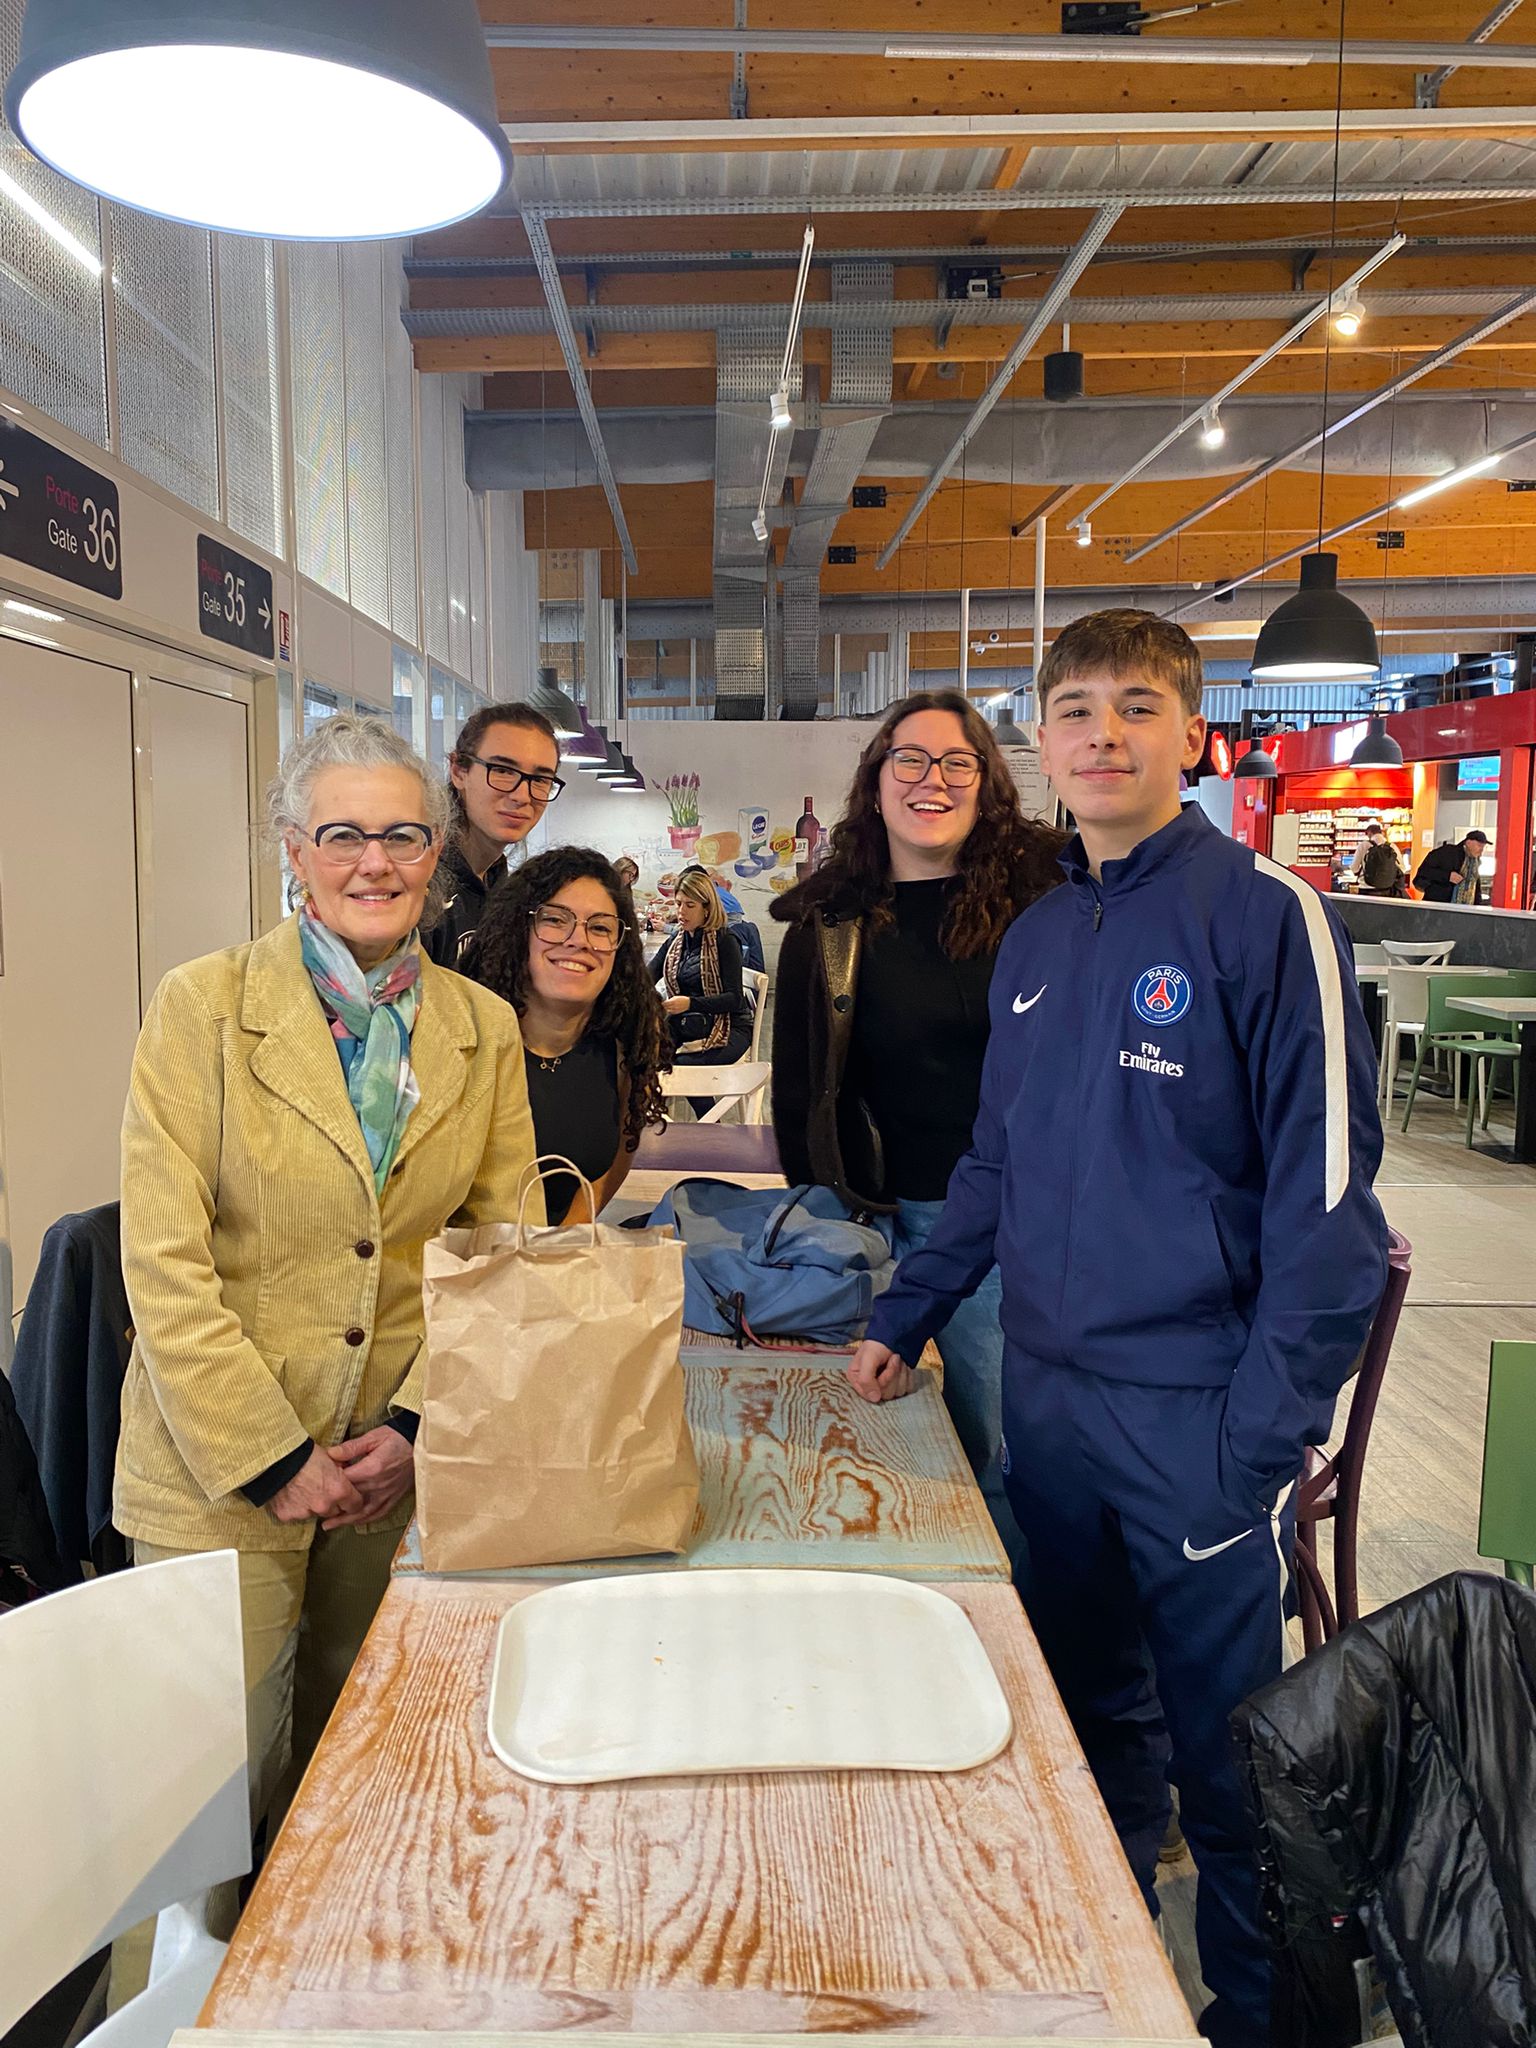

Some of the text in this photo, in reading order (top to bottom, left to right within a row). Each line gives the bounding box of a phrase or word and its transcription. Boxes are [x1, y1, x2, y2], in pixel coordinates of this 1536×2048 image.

[46, 475, 78, 513] Porte
[48, 518, 78, 554] Gate
[82, 497, 117, 571] 36
[202, 591, 222, 617] Gate
[224, 571, 246, 627] 35
[1147, 968, 1183, 984] PARIS
[1119, 1050, 1184, 1077] Emirates
[1141, 1041, 1161, 1058] Fly
